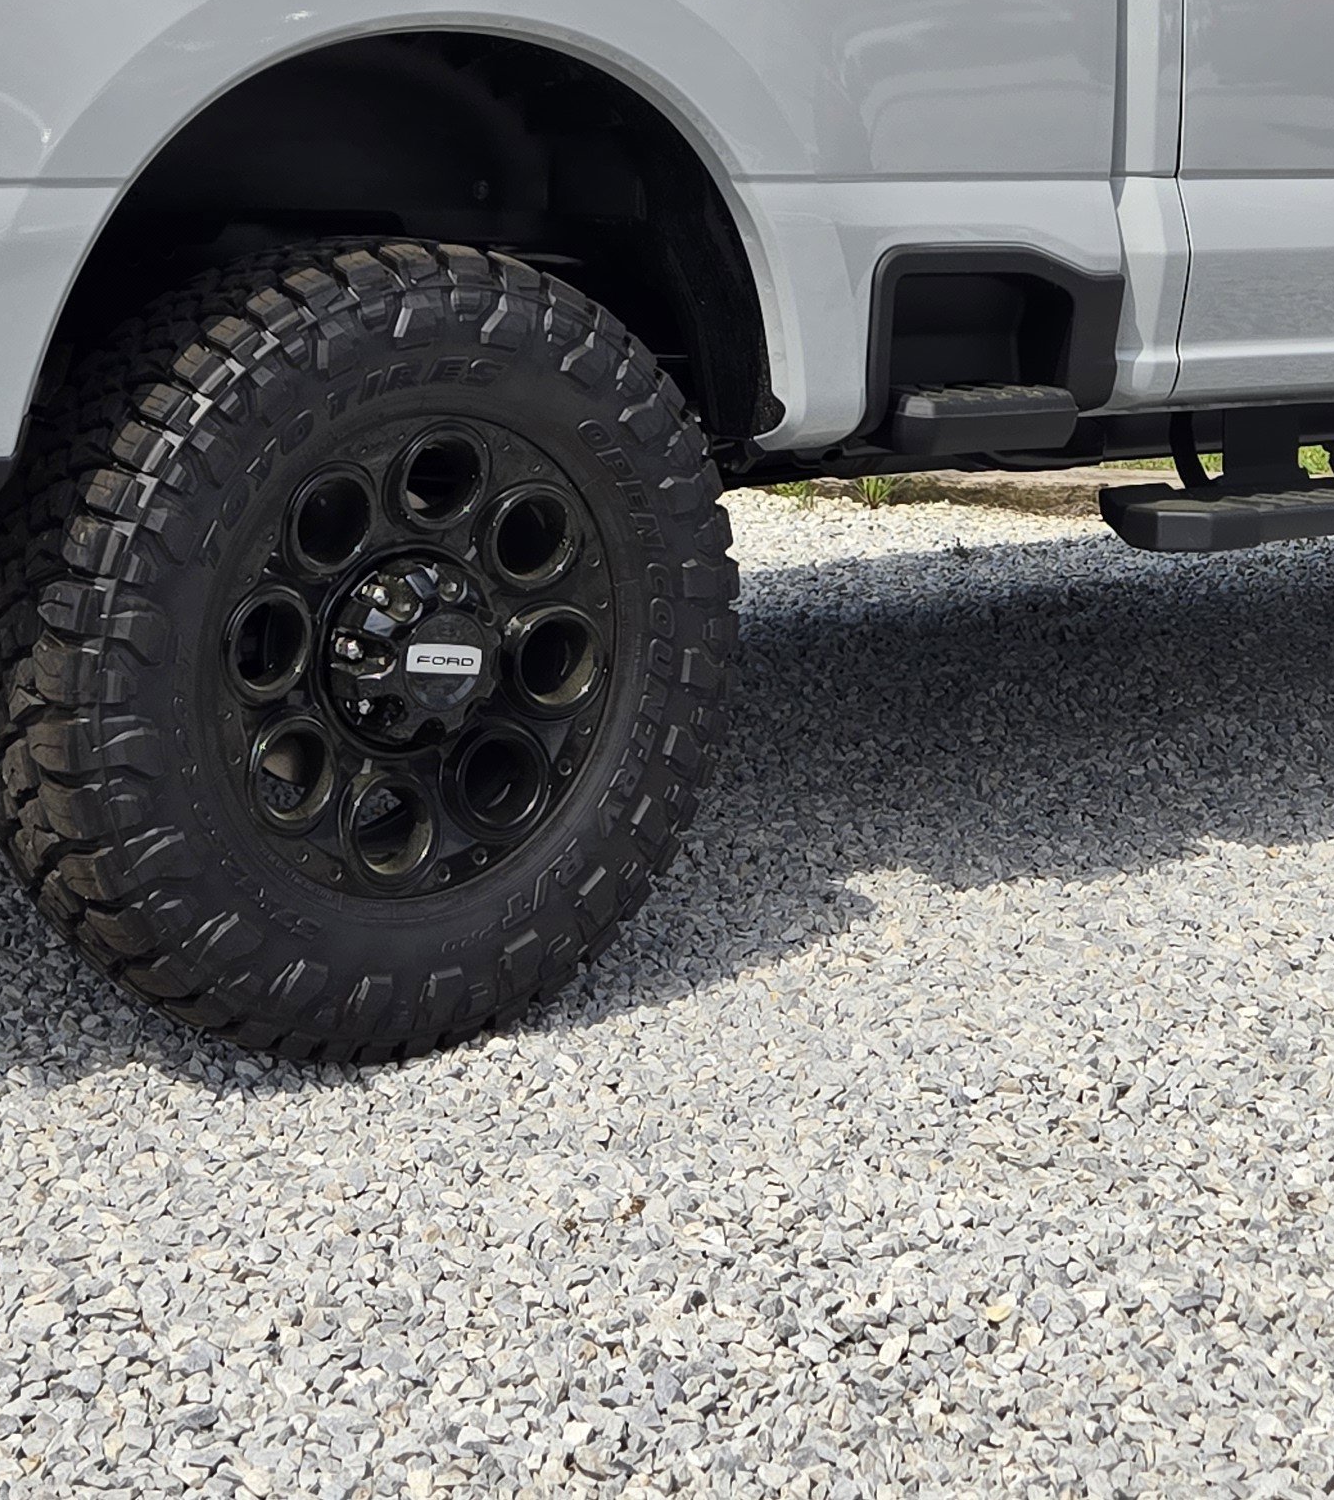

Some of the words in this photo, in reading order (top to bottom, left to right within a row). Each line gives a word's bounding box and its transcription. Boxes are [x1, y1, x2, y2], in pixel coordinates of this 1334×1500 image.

[198, 408, 314, 571] TOYO
[325, 354, 508, 421] TIRES
[575, 416, 667, 550] OPEN
[416, 654, 474, 668] FORD
[597, 561, 674, 839] COUNTRY
[501, 836, 585, 931] R/T
